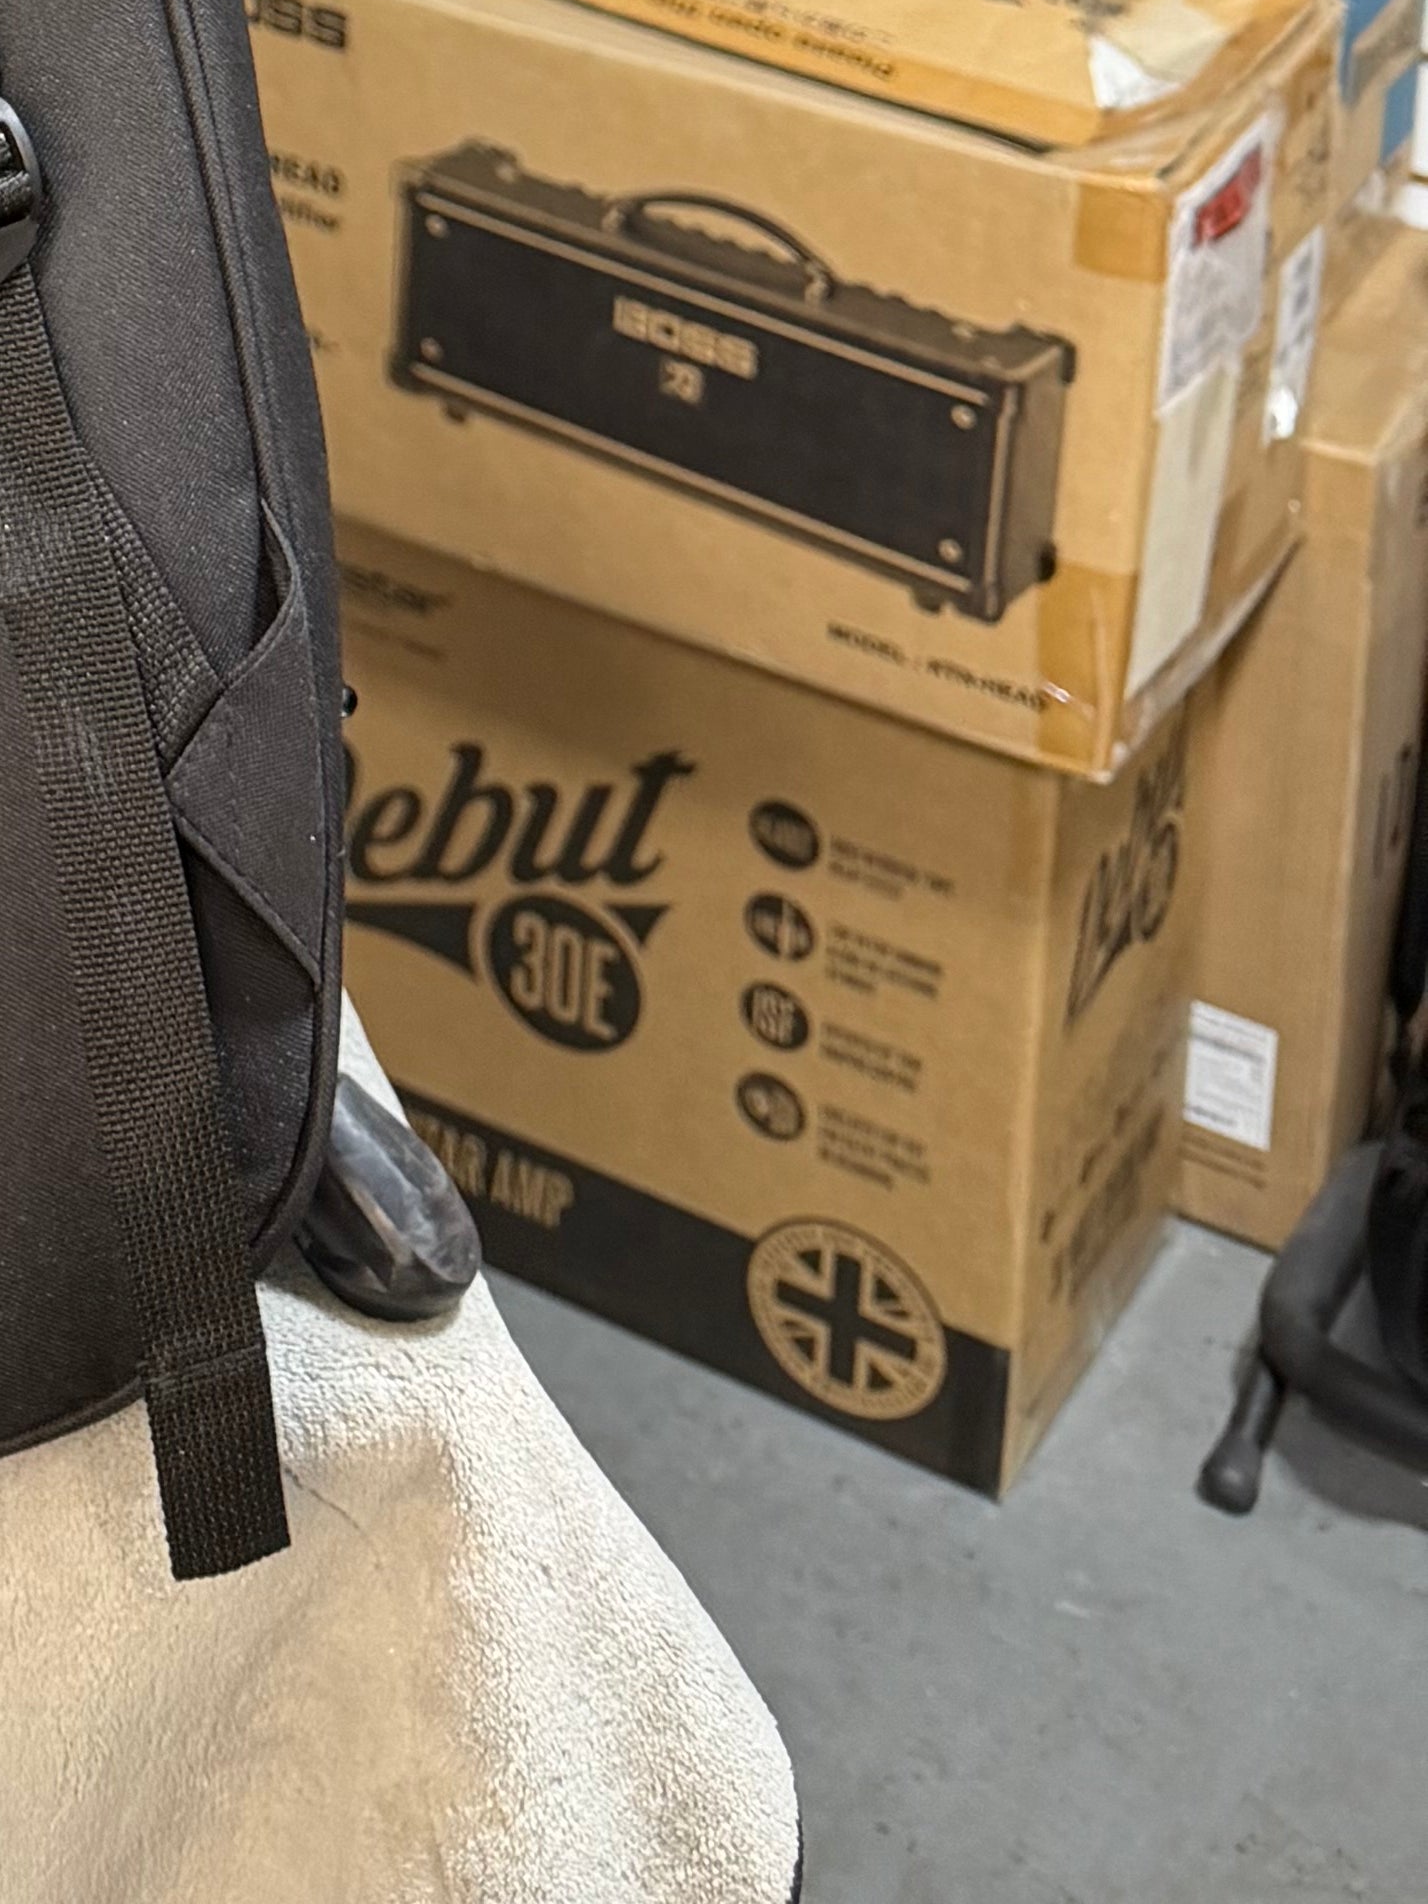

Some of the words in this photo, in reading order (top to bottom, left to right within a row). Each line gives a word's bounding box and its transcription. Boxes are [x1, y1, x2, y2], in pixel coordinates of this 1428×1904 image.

[612, 295, 759, 382] BOSS
[344, 742, 697, 885] ebut
[510, 910, 620, 1042] 30E
[490, 1148, 575, 1230] AMP
